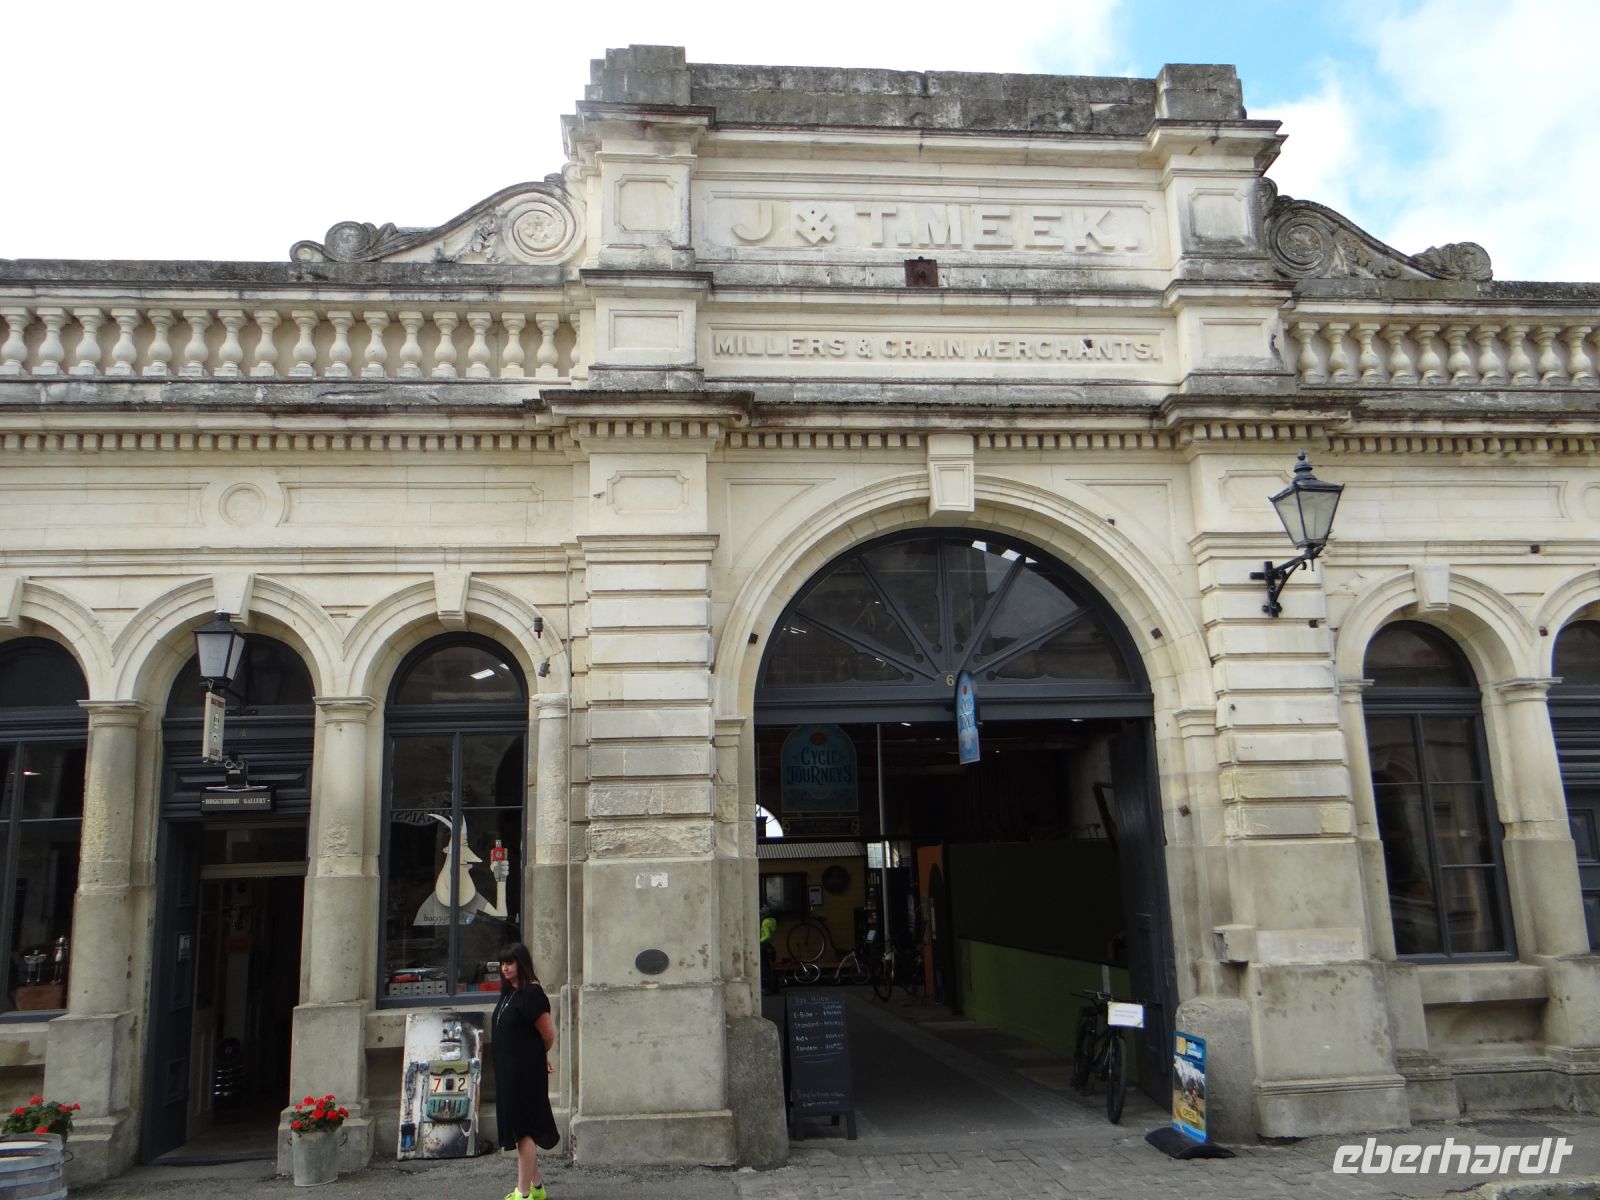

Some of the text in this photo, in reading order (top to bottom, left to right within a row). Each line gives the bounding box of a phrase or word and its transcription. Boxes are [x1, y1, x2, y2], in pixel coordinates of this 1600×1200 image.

[730, 201, 774, 242] J
[796, 203, 836, 244] &
[713, 335, 846, 358] MILLERS
[857, 338, 873, 359] &
[946, 674, 954, 686] 6
[786, 765, 852, 785] JOURNEYS
[433, 1077, 465, 1092] 7 2
